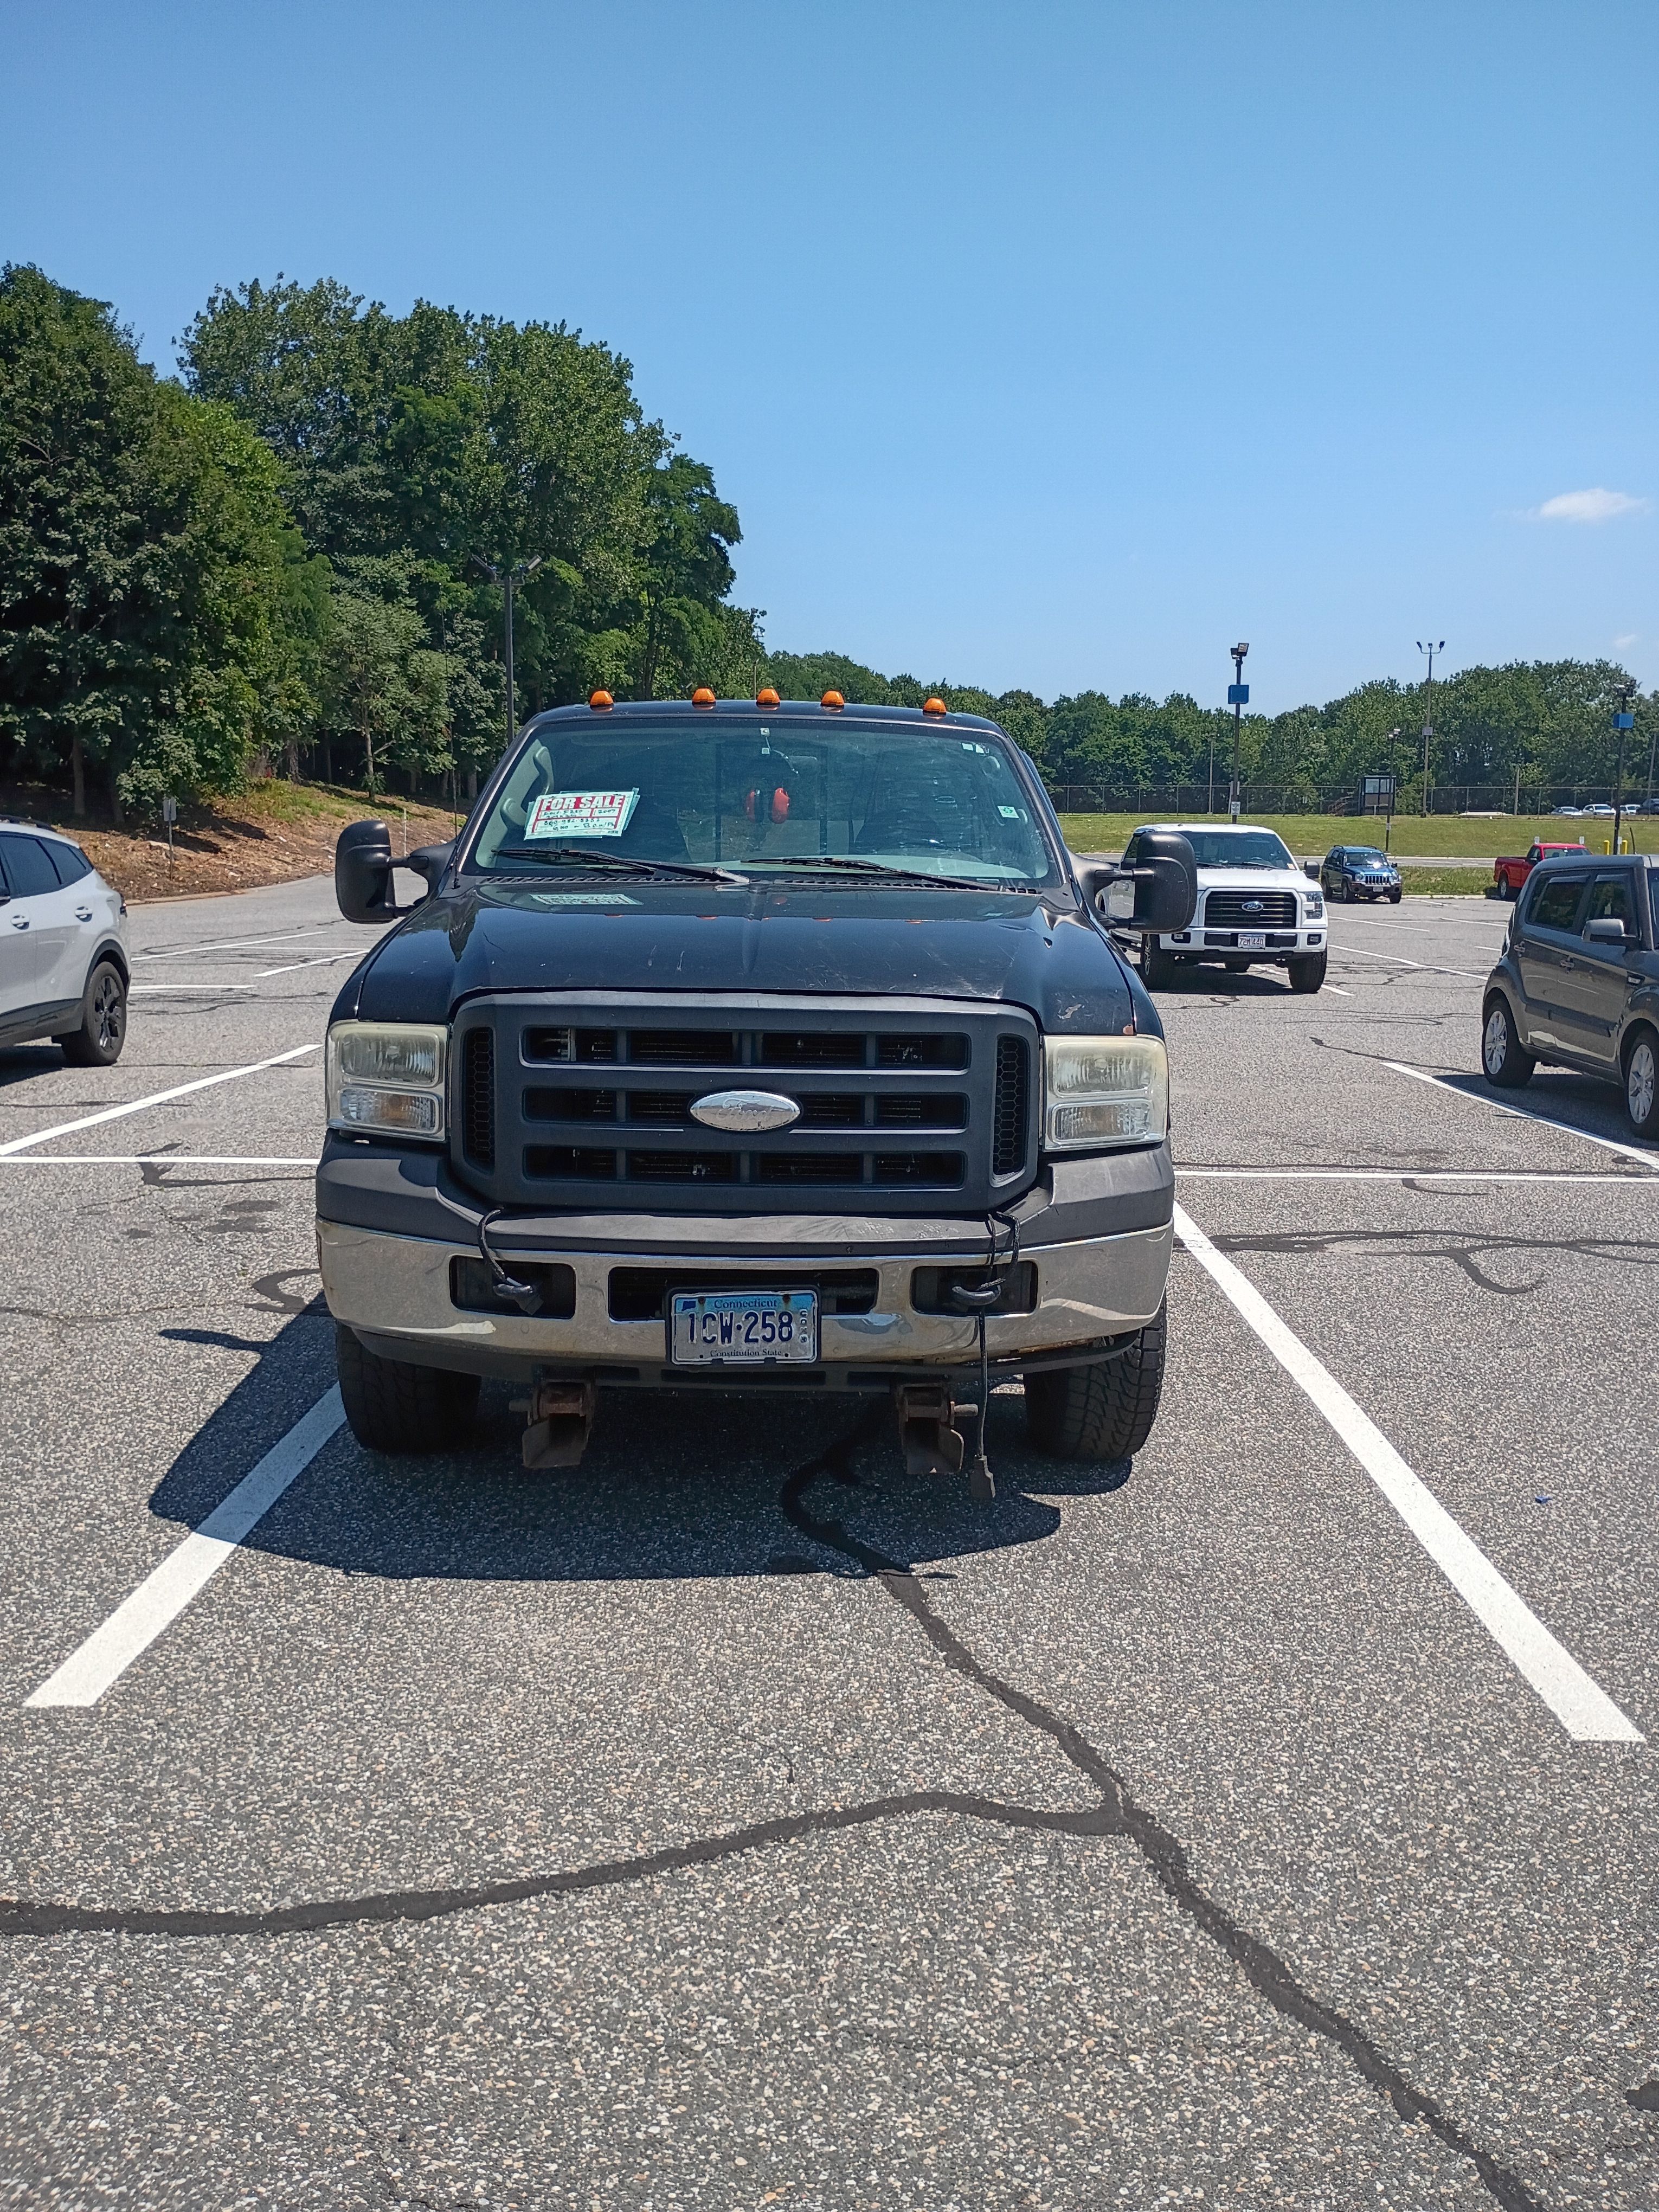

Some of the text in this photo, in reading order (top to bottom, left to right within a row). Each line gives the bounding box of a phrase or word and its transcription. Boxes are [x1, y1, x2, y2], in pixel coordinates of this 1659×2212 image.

[541, 795, 625, 811] FOR SALE
[1252, 937, 1264, 946] 440
[715, 1098, 786, 1122] Ford
[713, 1298, 777, 1309] Connecticut
[710, 1348, 782, 1358] Constitution State
